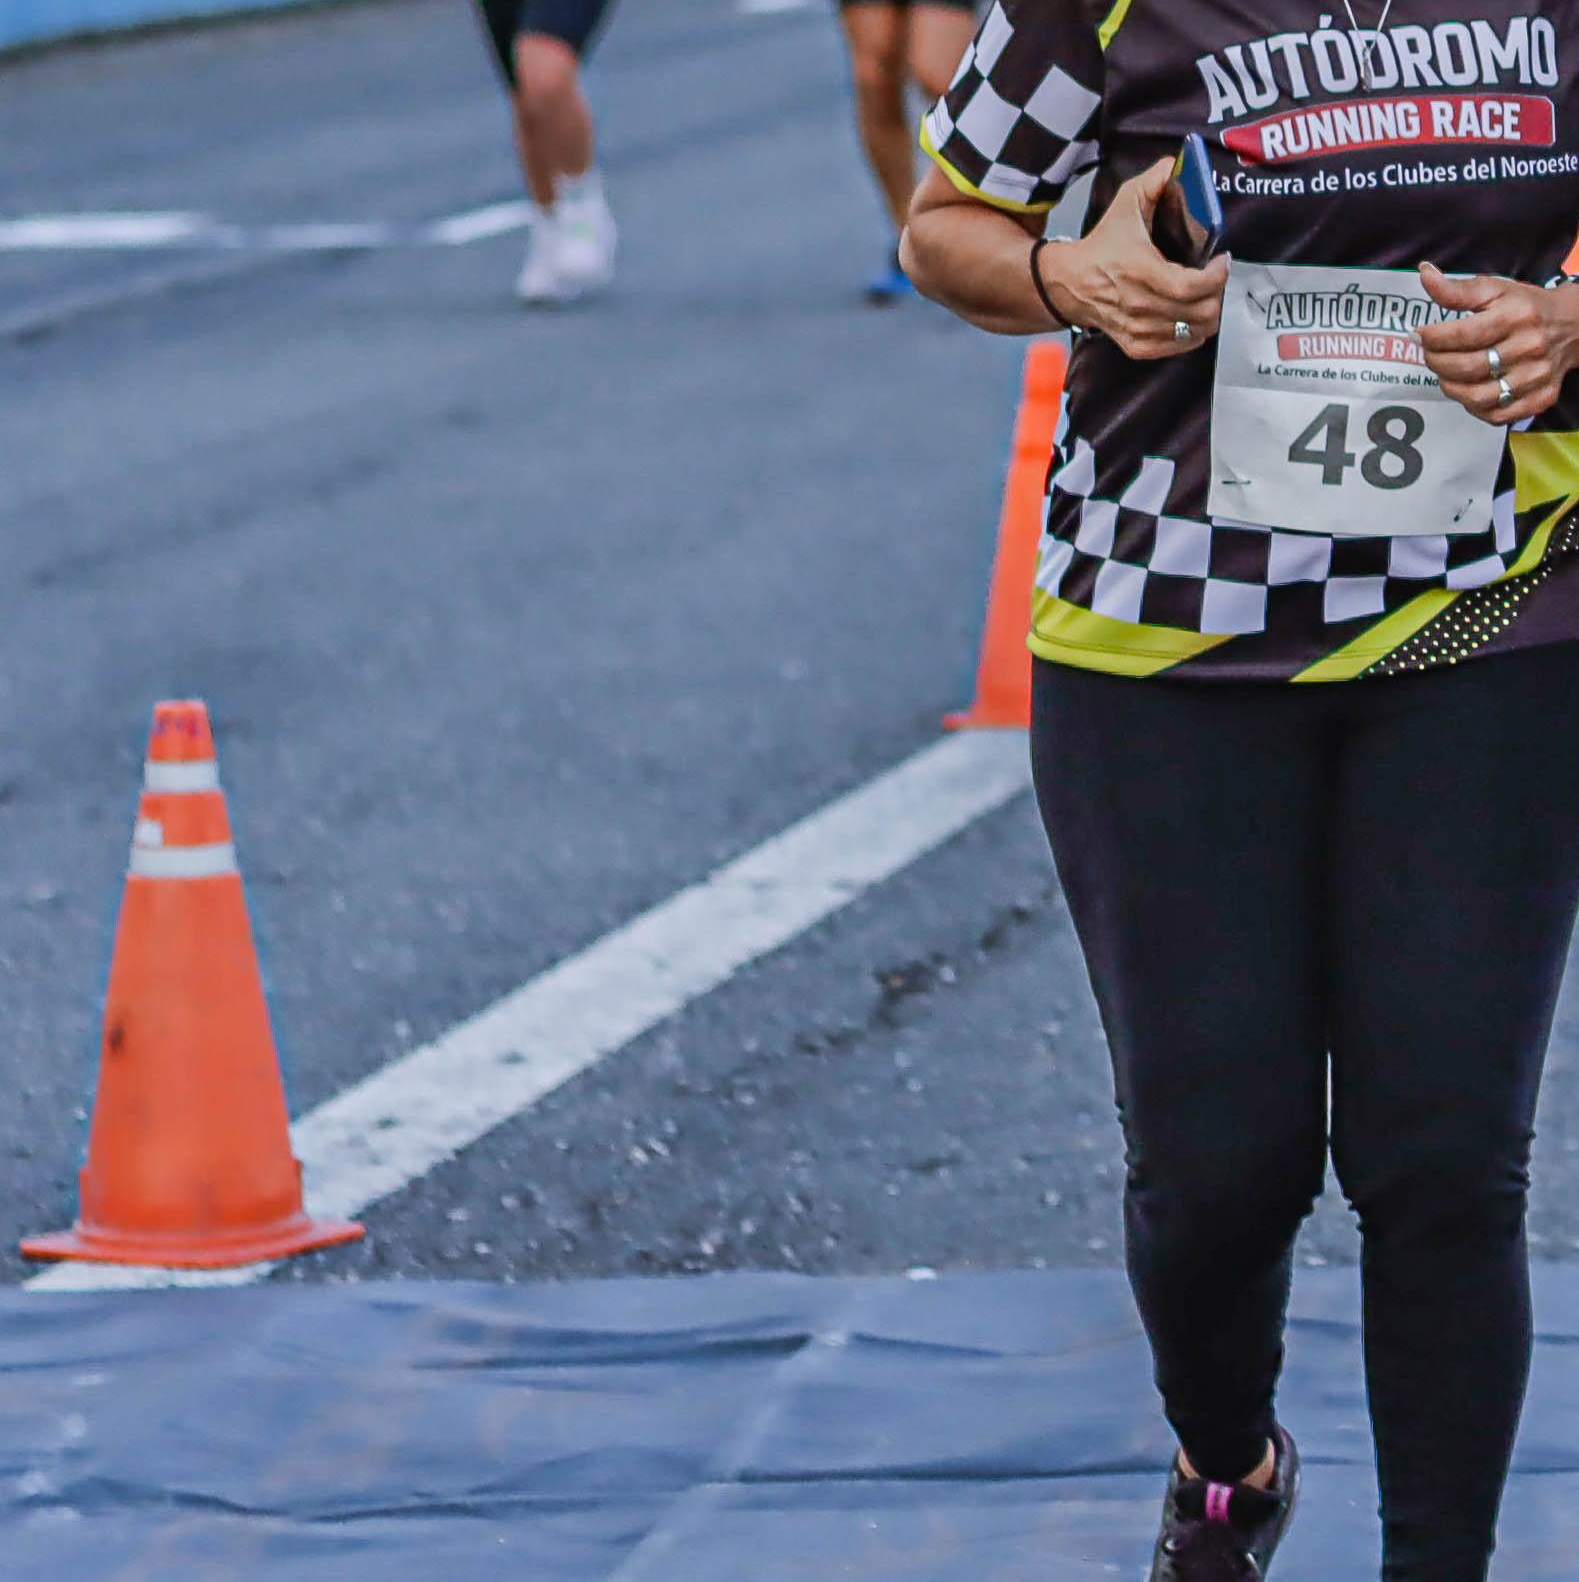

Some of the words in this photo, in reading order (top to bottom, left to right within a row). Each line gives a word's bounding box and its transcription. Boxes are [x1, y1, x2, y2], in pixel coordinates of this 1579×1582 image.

[1196, 14, 1560, 124] AUTÓDROMO
[1260, 101, 1421, 161] RUNNING
[1430, 100, 1521, 141] RACE
[1214, 170, 1231, 192] La
[1235, 172, 1304, 195] Carrera
[1311, 170, 1339, 193] de
[1345, 166, 1377, 190] los
[1383, 162, 1457, 187] Clubes
[1463, 156, 1495, 182] del
[1501, 152, 1579, 179] Noroeste
[1299, 335, 1385, 358] RUNNING
[1257, 364, 1271, 375] La
[1274, 365, 1319, 379] Carrera
[1322, 367, 1337, 380] de
[1340, 368, 1357, 382] los
[1360, 370, 1400, 385] Clubes
[1403, 373, 1421, 386] del
[1287, 403, 1425, 490] 48
